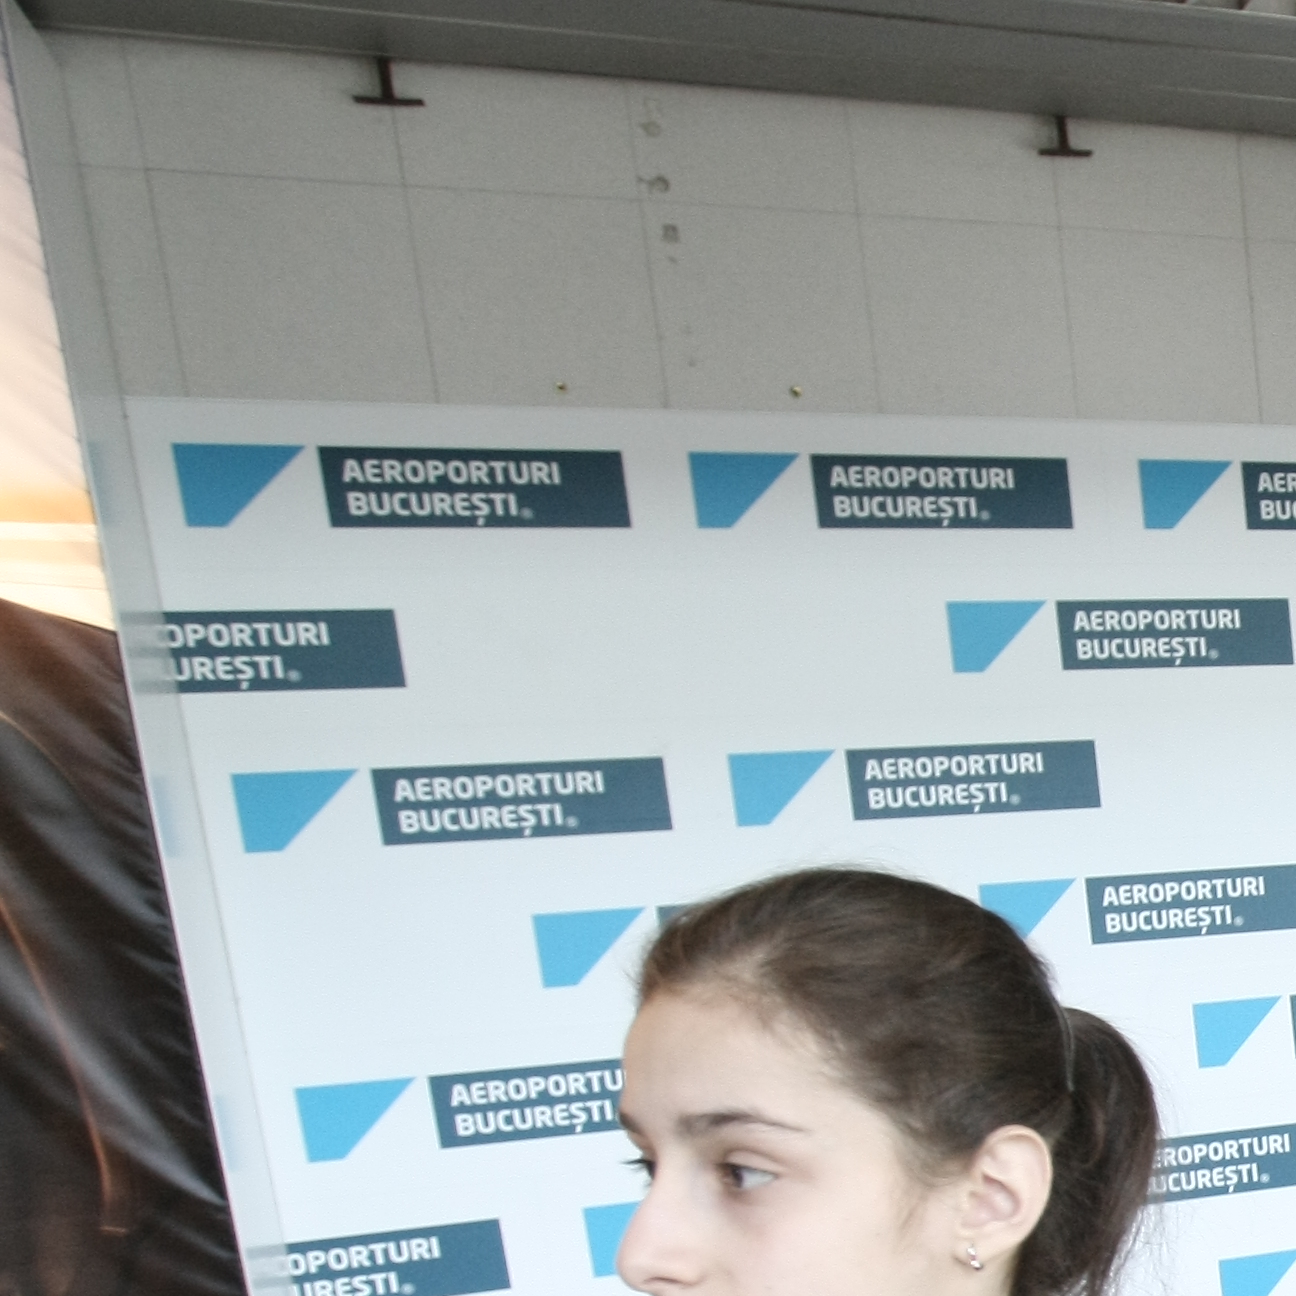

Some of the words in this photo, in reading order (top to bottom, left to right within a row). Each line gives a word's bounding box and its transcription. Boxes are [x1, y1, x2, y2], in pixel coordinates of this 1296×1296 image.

[342, 458, 560, 486] AEROPORTURI
[829, 465, 1015, 491] AEROPORTURI
[166, 621, 330, 648] OPORTURI
[1073, 607, 1241, 632] AEROPORTURI
[172, 655, 285, 690] UREȘTI
[863, 752, 1044, 781] AEROPORTURI
[394, 771, 604, 802] AEROPORTURI
[1101, 876, 1266, 907] AEROPORTURI
[451, 1068, 623, 1107] AEROPORTU
[1155, 1133, 1290, 1168] ROPORTURI
[1149, 1163, 1258, 1193] UCUREȘTI
[288, 1236, 441, 1277] OPORTURI
